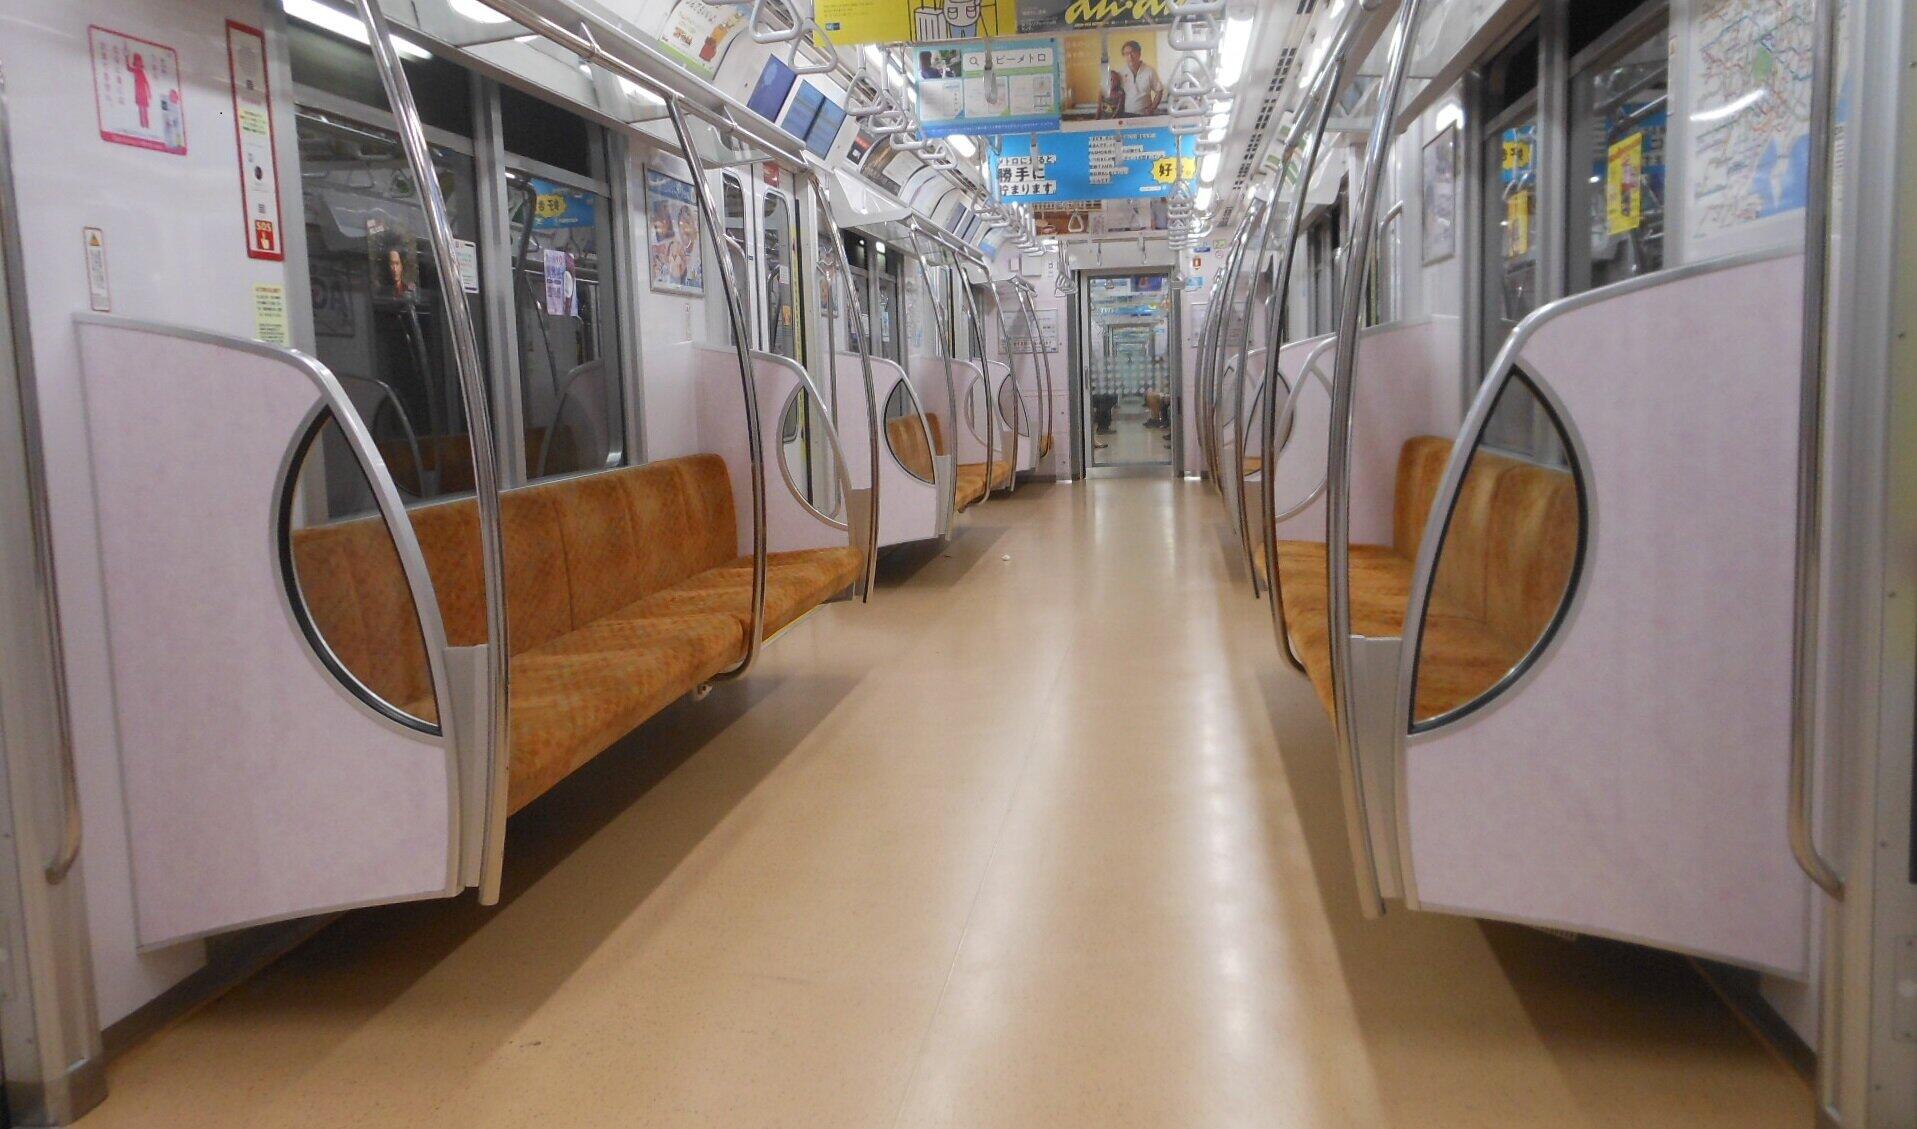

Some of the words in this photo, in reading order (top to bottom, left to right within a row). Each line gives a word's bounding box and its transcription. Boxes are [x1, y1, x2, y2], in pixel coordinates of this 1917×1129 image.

[998, 166, 1045, 183] 勝手に
[256, 221, 272, 231] SOS
